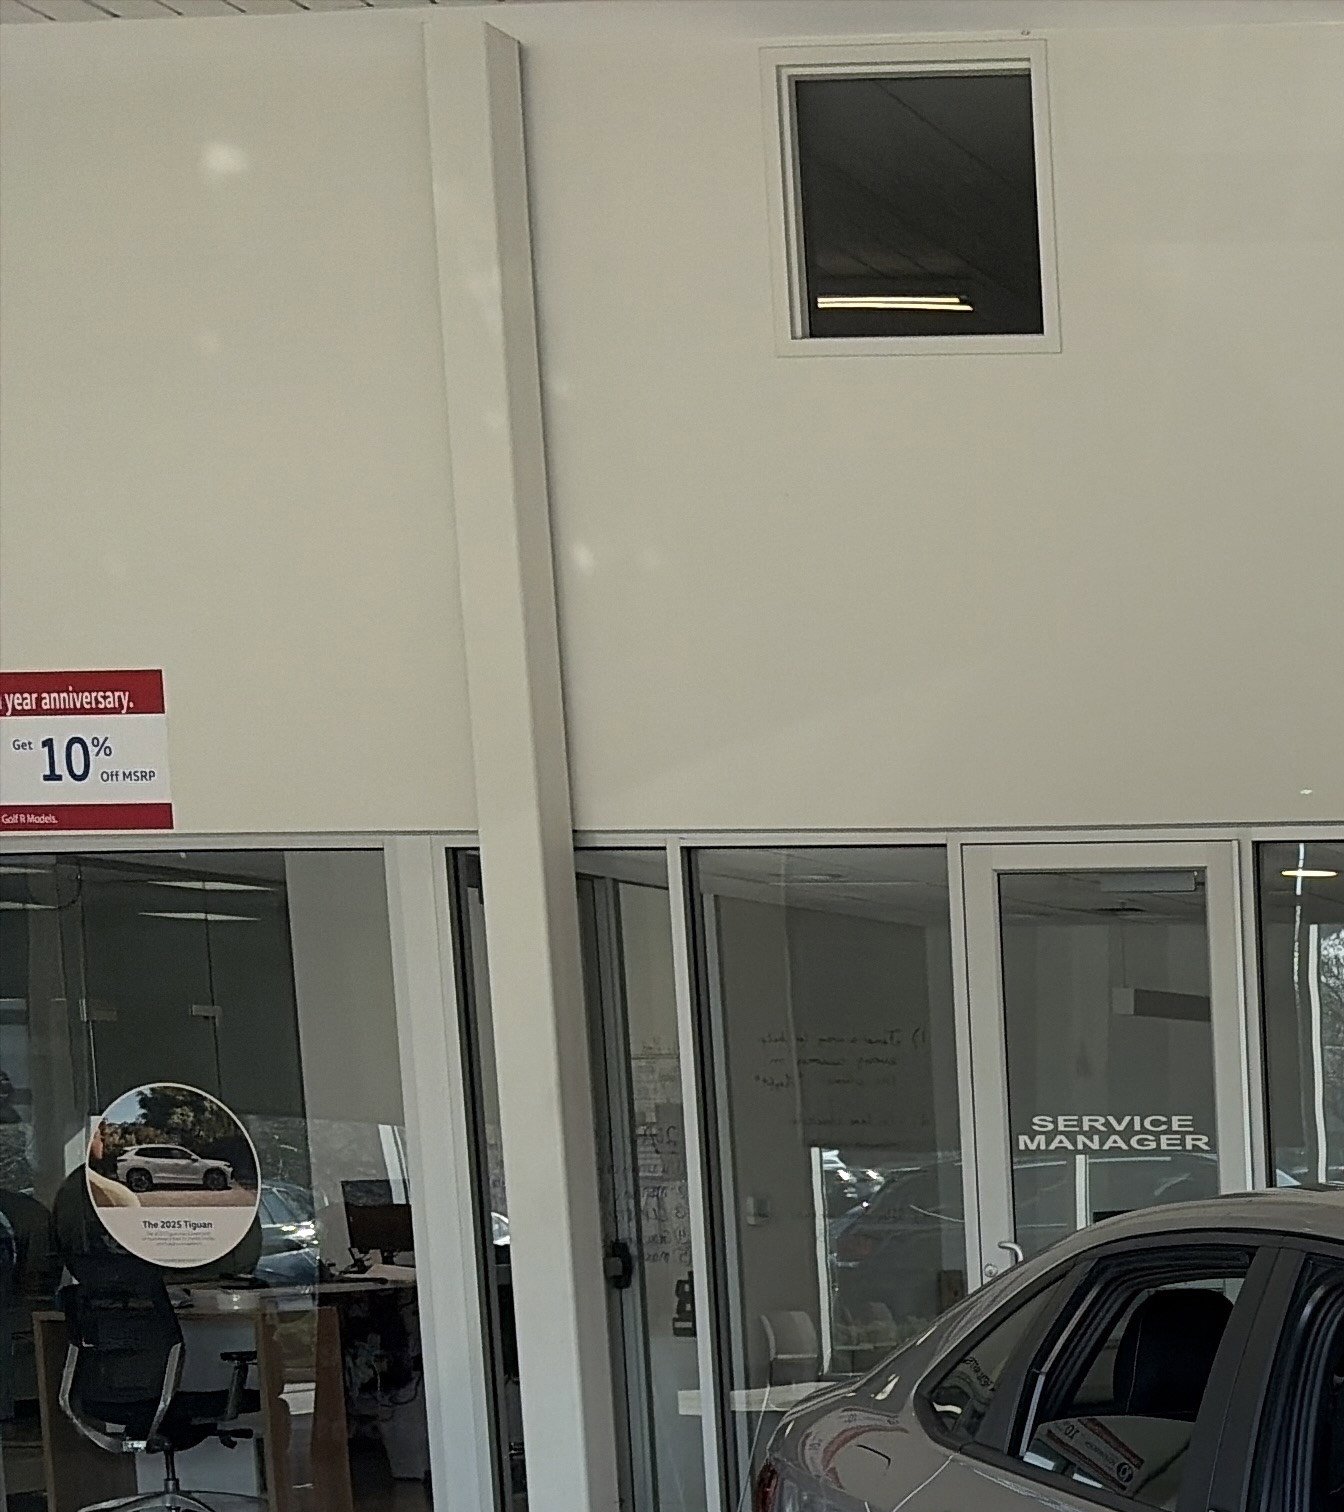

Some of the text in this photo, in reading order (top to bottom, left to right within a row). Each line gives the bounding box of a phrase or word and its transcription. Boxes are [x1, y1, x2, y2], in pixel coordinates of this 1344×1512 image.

[5, 686, 134, 715] year anniversary.
[13, 739, 33, 751] Get
[100, 771, 119, 783] Off
[122, 770, 156, 782] MSRP
[1, 813, 19, 824] Golf
[27, 813, 58, 824] Models.
[1032, 1115, 1194, 1131] SERVICE
[1018, 1134, 1211, 1150] MANAGER
[143, 1220, 213, 1231] The 2025 Tiguan
